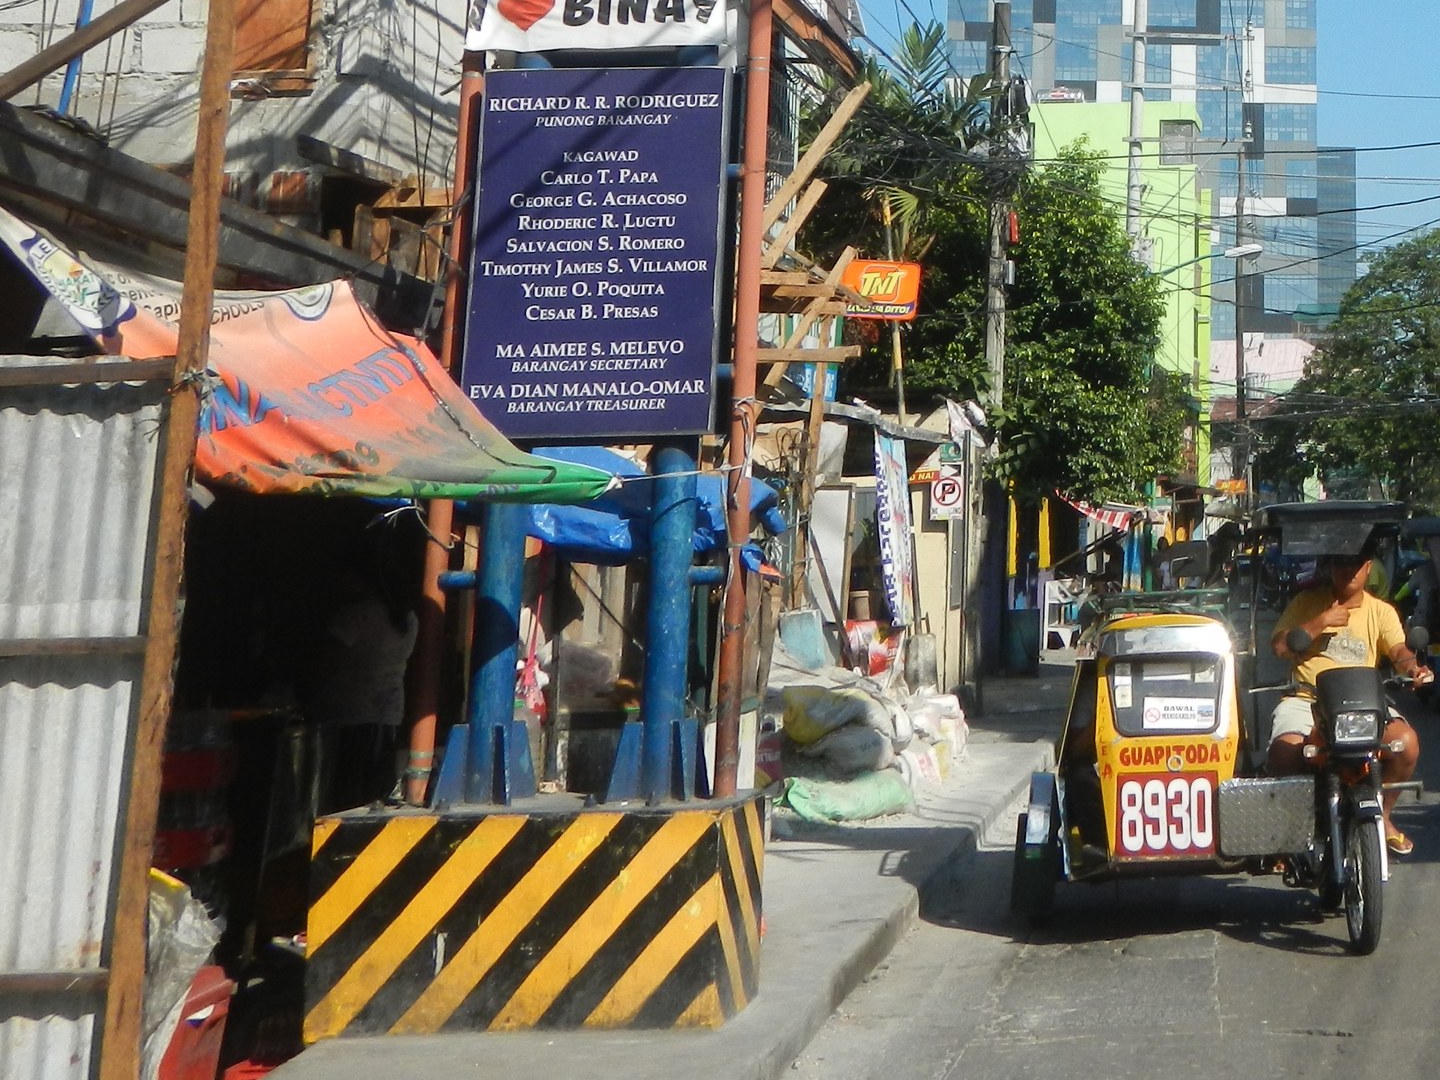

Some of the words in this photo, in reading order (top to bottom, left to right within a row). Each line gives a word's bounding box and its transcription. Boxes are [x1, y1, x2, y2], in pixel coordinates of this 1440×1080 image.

[489, 96, 571, 112] RICHARD
[574, 96, 590, 110] R.
[595, 95, 610, 110] R.
[615, 94, 720, 110] RODRIGUEZ
[535, 115, 594, 127] PUNONG
[597, 114, 672, 127] BARANGAY
[563, 151, 639, 163] KAGAWAD
[597, 169, 614, 184] T.
[577, 191, 597, 207] G.
[601, 213, 619, 229] R.
[598, 236, 614, 251] S.
[607, 258, 624, 273] S.
[572, 281, 592, 297] O.
[860, 271, 905, 297] TNT
[211, 301, 265, 325] CHOOLS
[581, 304, 597, 320] B.
[884, 305, 911, 314] DITO!
[495, 344, 525, 359] MA
[530, 342, 587, 358] AIMEE
[591, 342, 606, 356] S.
[609, 340, 685, 356] MELEVO
[511, 360, 588, 373] BARANGAY
[590, 358, 668, 371] SECRETARY
[469, 384, 506, 400] EVA
[511, 383, 559, 399] DIAN
[562, 379, 705, 397] MANALO-OMAR
[507, 400, 584, 414] BARANGAY
[586, 398, 667, 412] TREASURER
[918, 471, 935, 480] NA!
[1119, 743, 1220, 767] GUAPITODA
[1120, 777, 1213, 852] 8930
